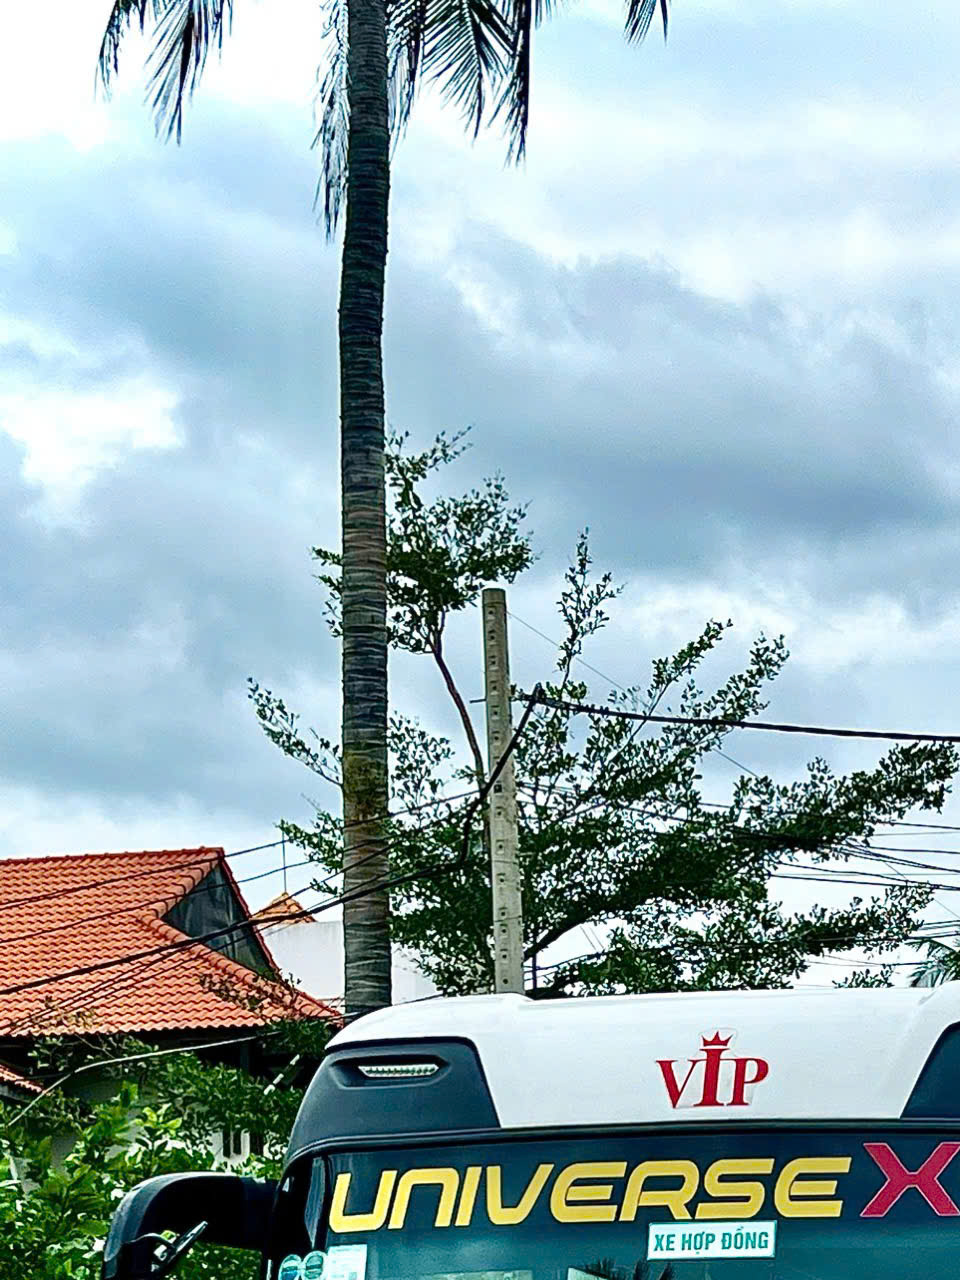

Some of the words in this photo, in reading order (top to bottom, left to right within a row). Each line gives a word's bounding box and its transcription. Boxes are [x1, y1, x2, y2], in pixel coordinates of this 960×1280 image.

[655, 1047, 769, 1109] VIP
[328, 1156, 853, 1234] UNIVERSE
[653, 1233, 676, 1252] XE
[681, 1231, 716, 1255] HỢP
